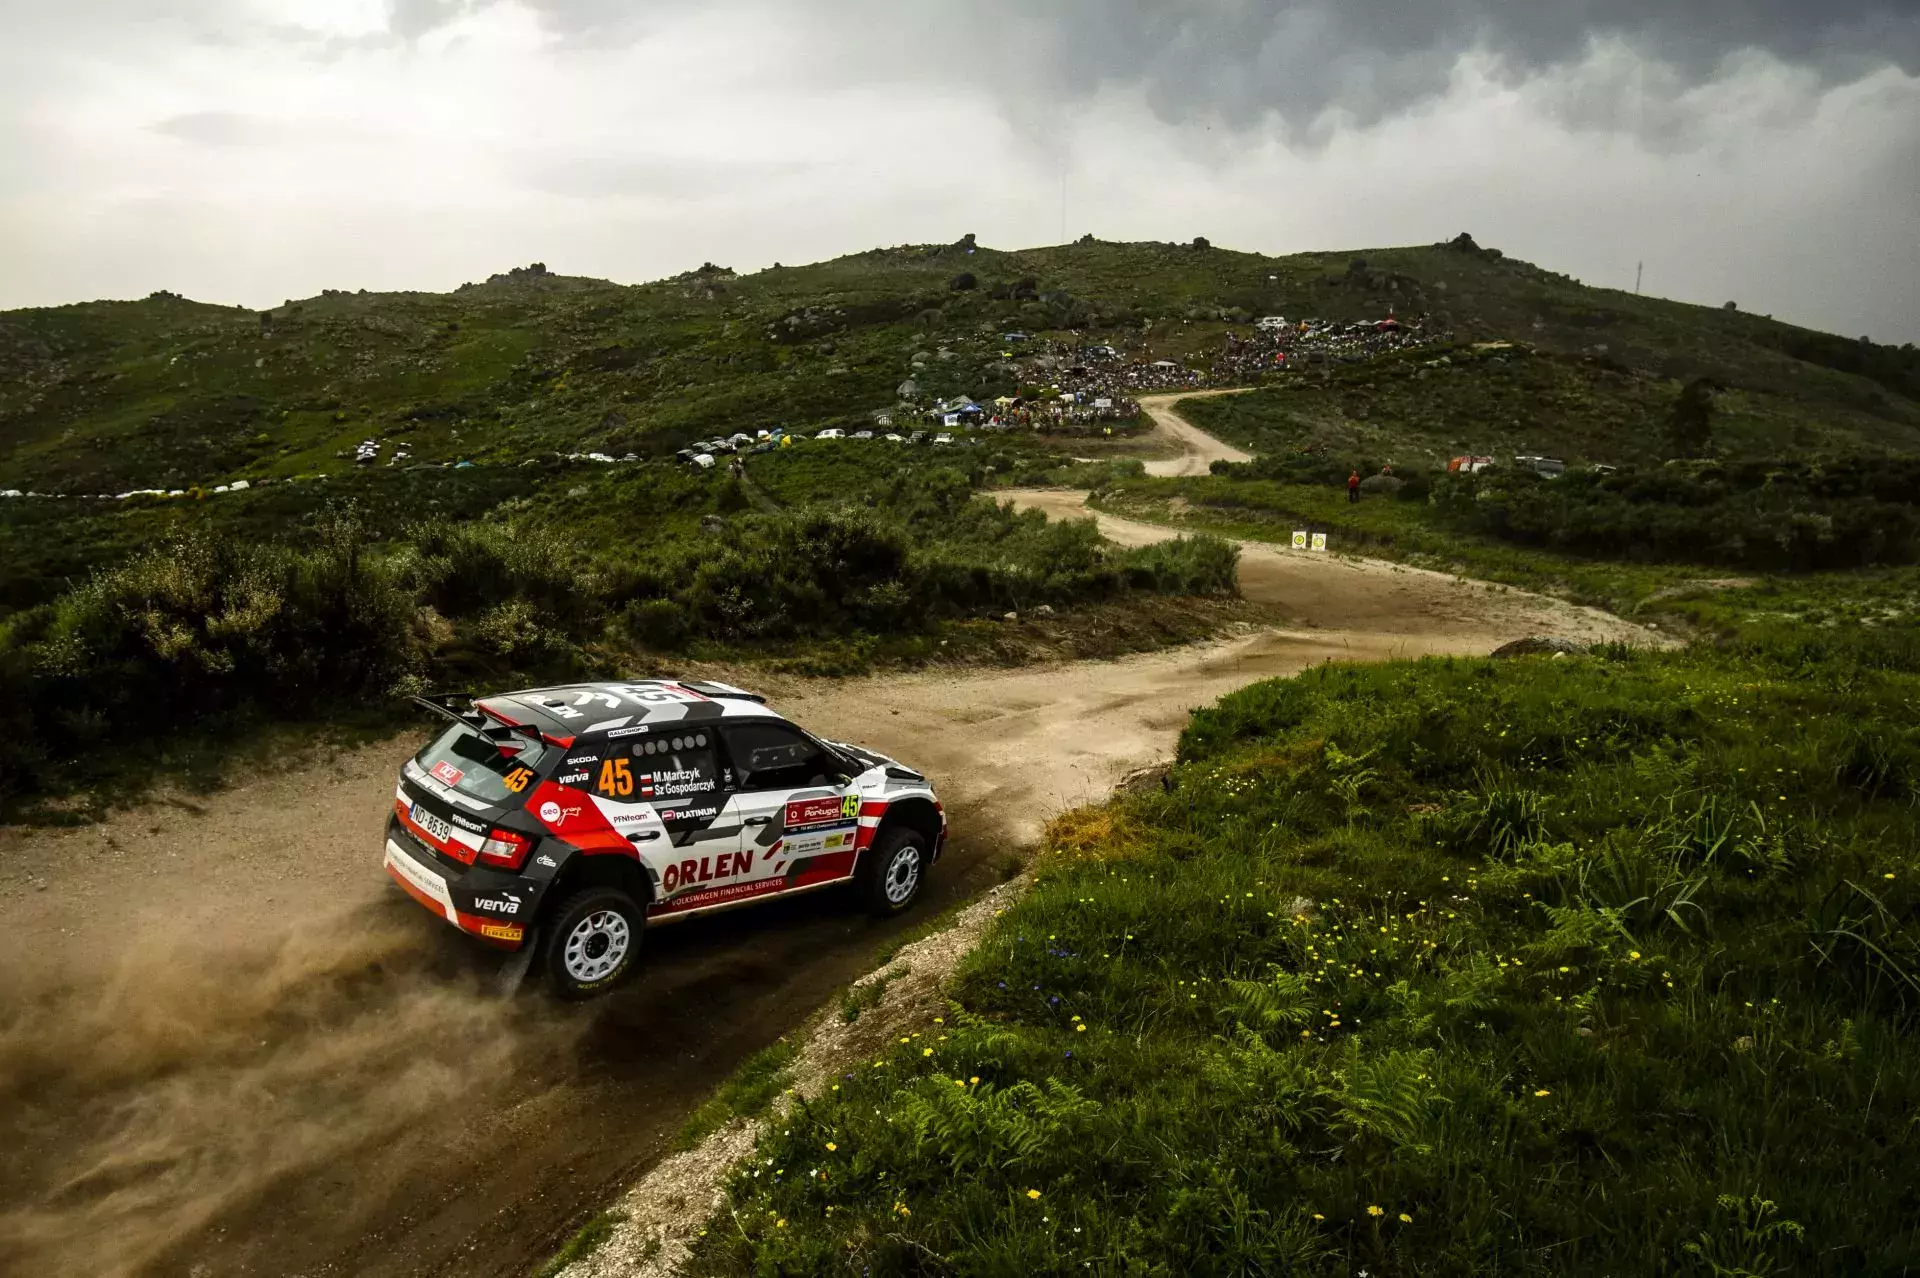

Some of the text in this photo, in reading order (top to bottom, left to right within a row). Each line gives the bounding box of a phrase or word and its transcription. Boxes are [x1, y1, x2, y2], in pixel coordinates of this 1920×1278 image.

[502, 767, 533, 792] 45
[559, 772, 589, 784] verva
[599, 758, 634, 796] 45
[654, 784, 664, 796] Sz
[665, 779, 715, 795] Gospodarczyk
[676, 807, 716, 819] PLATINUM
[804, 806, 839, 817] Portugal
[842, 795, 858, 817] 45
[663, 850, 753, 892] ORLEN
[672, 890, 718, 906] VOLKSWAGEN
[720, 882, 753, 896] FINANCIAL
[754, 878, 783, 890] SERVICES
[475, 897, 519, 914] verva
